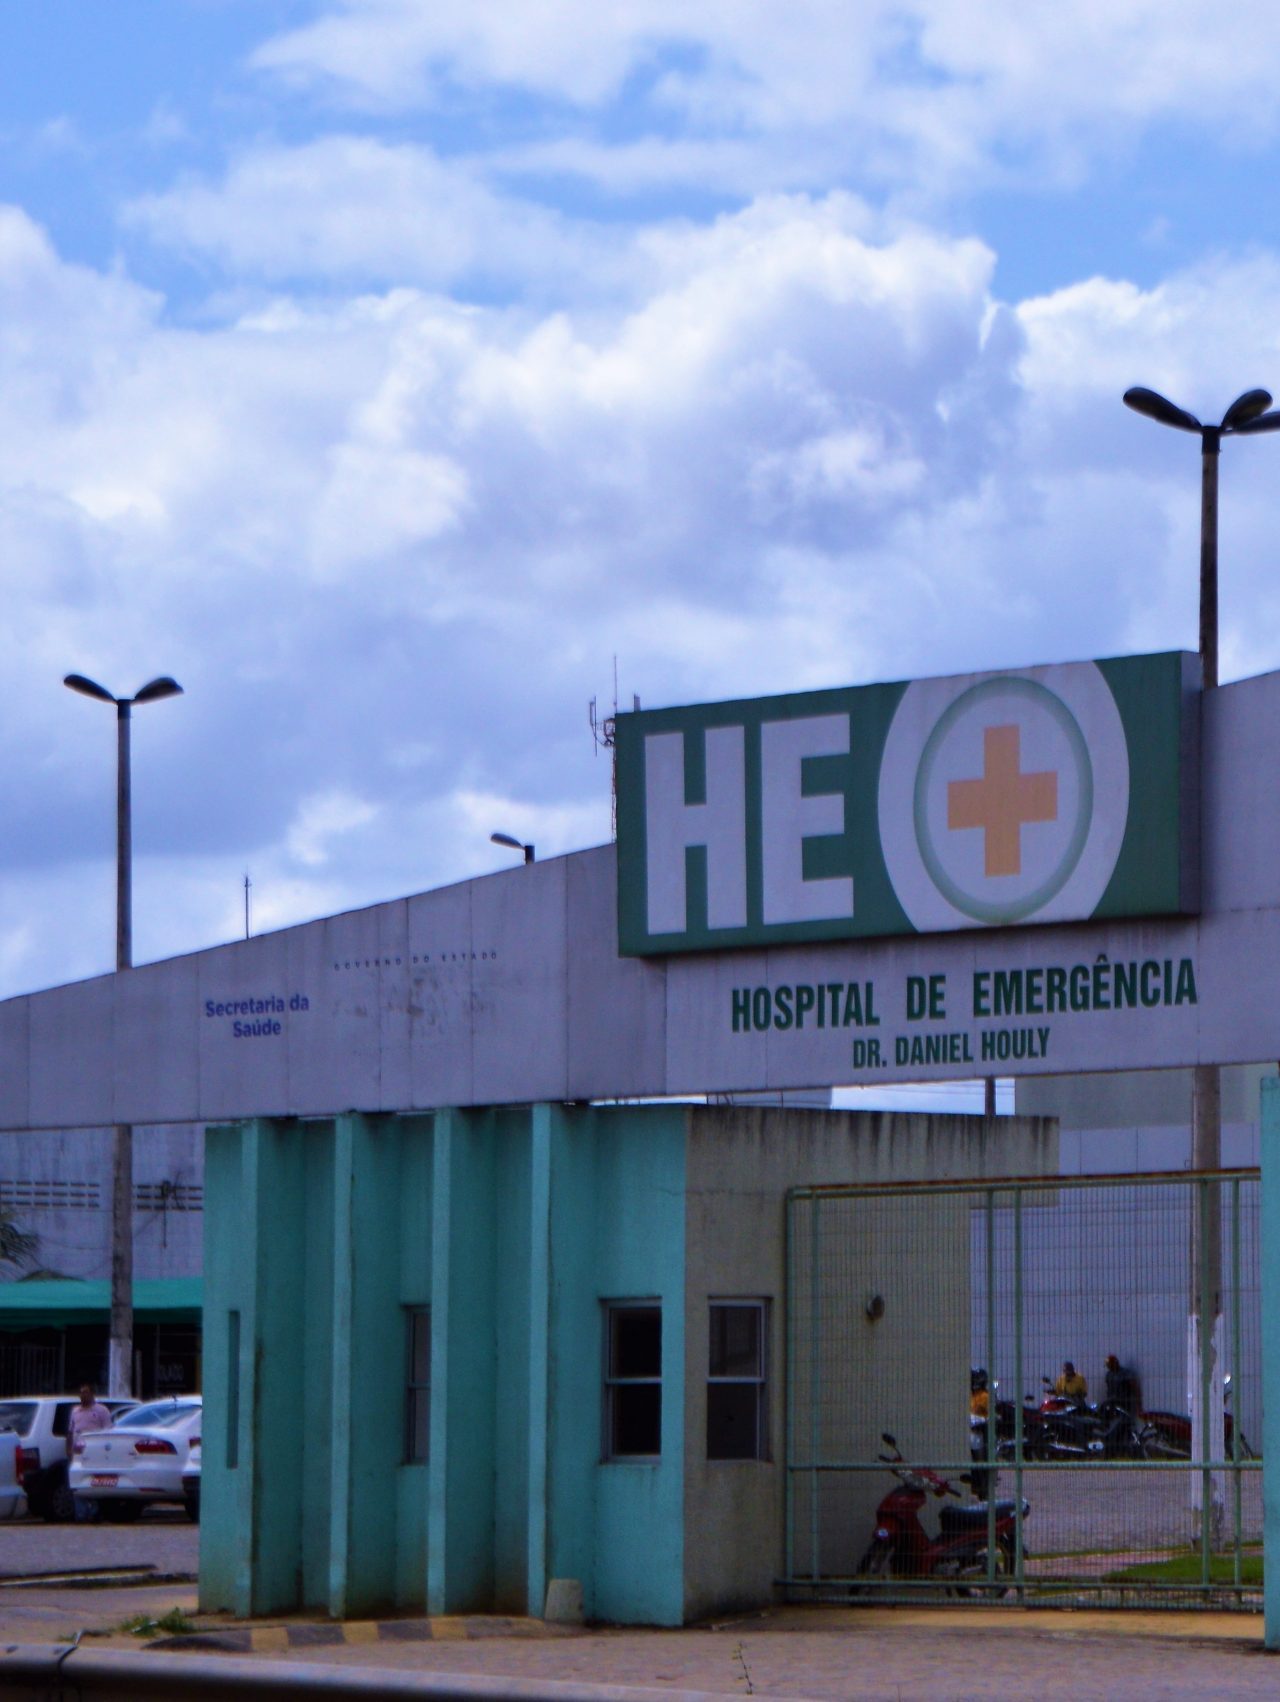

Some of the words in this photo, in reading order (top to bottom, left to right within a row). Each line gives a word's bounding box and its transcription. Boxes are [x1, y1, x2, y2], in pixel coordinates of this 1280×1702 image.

[645, 713, 854, 935] HE
[333, 959, 401, 971] GOVERNO
[413, 955, 430, 964] DO
[441, 951, 497, 961] ESTADO
[206, 996, 285, 1017] Secretaria
[289, 993, 310, 1012] da
[732, 983, 880, 1032] HOSPITAL
[906, 975, 946, 1021] DE
[973, 954, 1198, 1017] EMERGÊNCIA
[233, 1018, 282, 1038] Saúde
[853, 1038, 888, 1068] DR.
[895, 1033, 974, 1066] DANIEL
[981, 1027, 1050, 1060] HOULY
